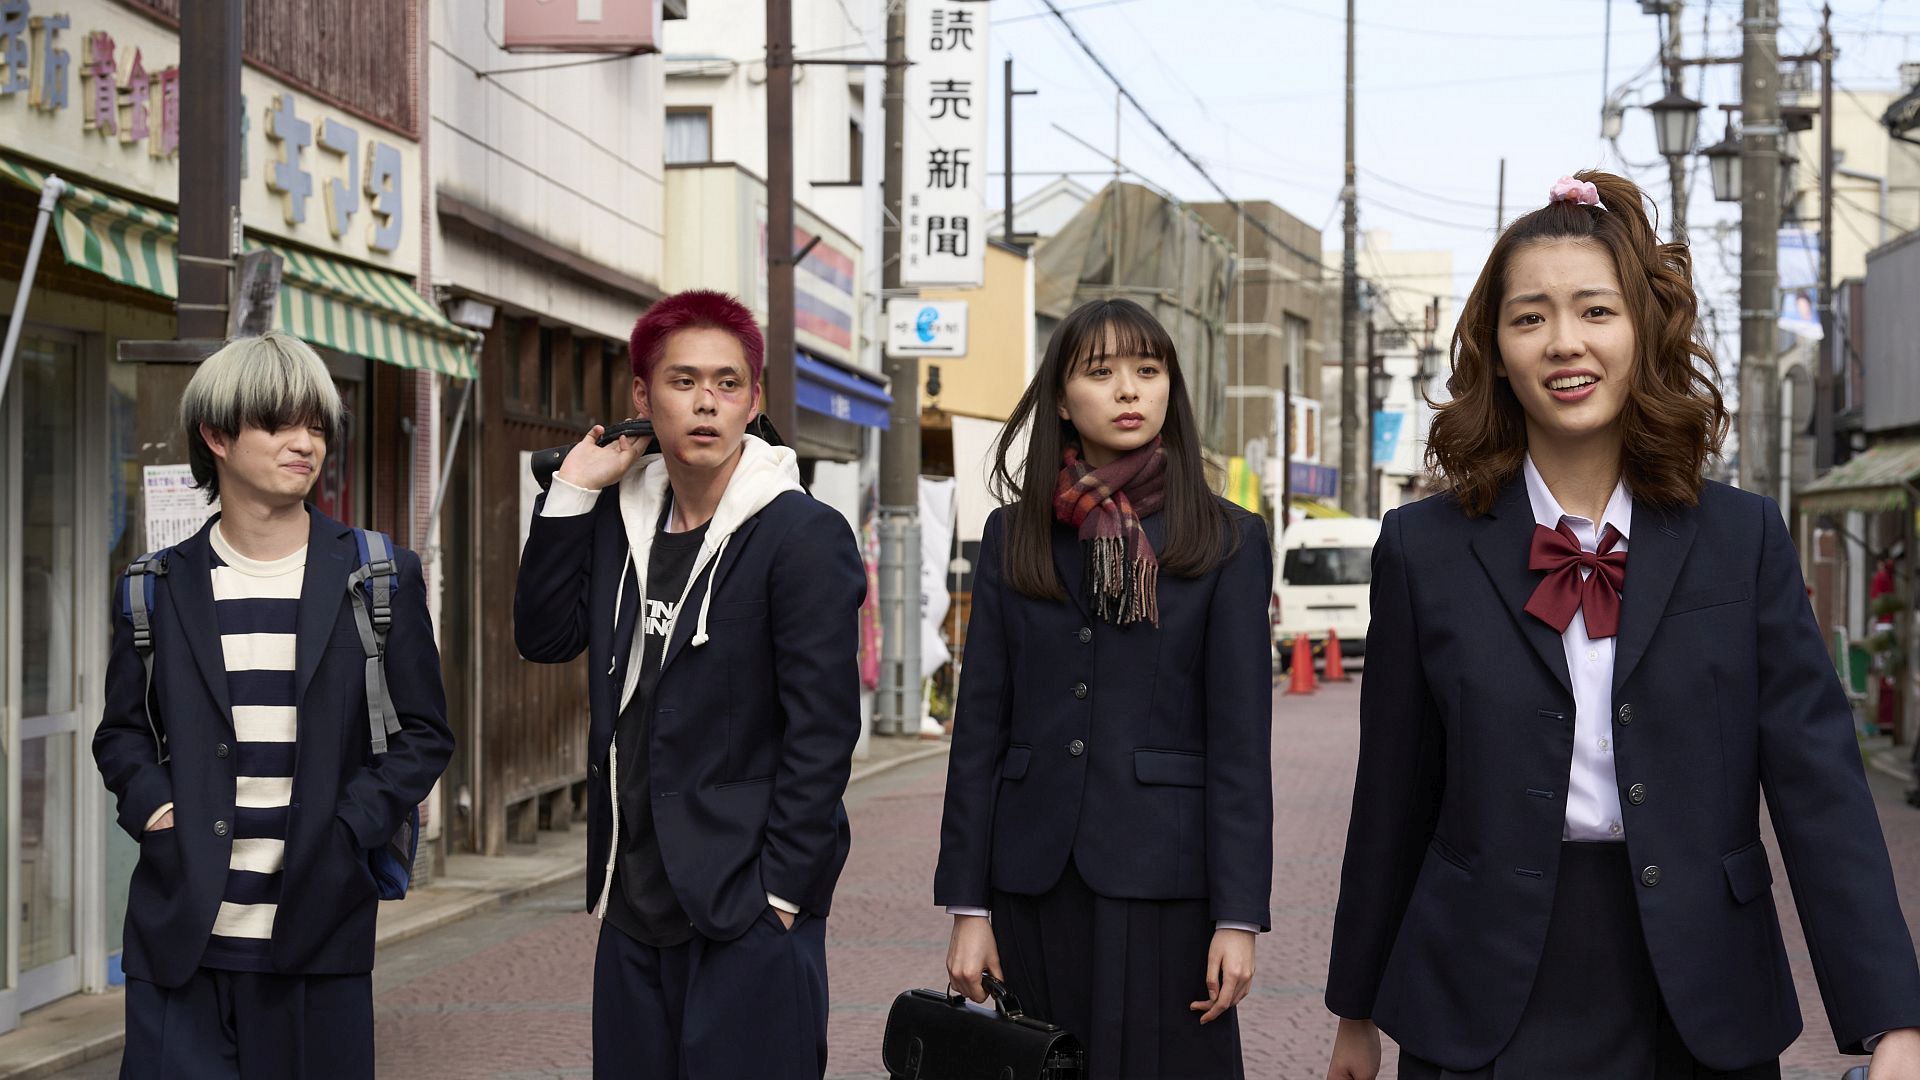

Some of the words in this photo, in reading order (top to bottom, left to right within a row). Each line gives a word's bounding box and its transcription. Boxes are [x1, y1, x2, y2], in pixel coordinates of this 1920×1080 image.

[265, 92, 403, 254] キマタ
[927, 10, 974, 257] 読売新聞
